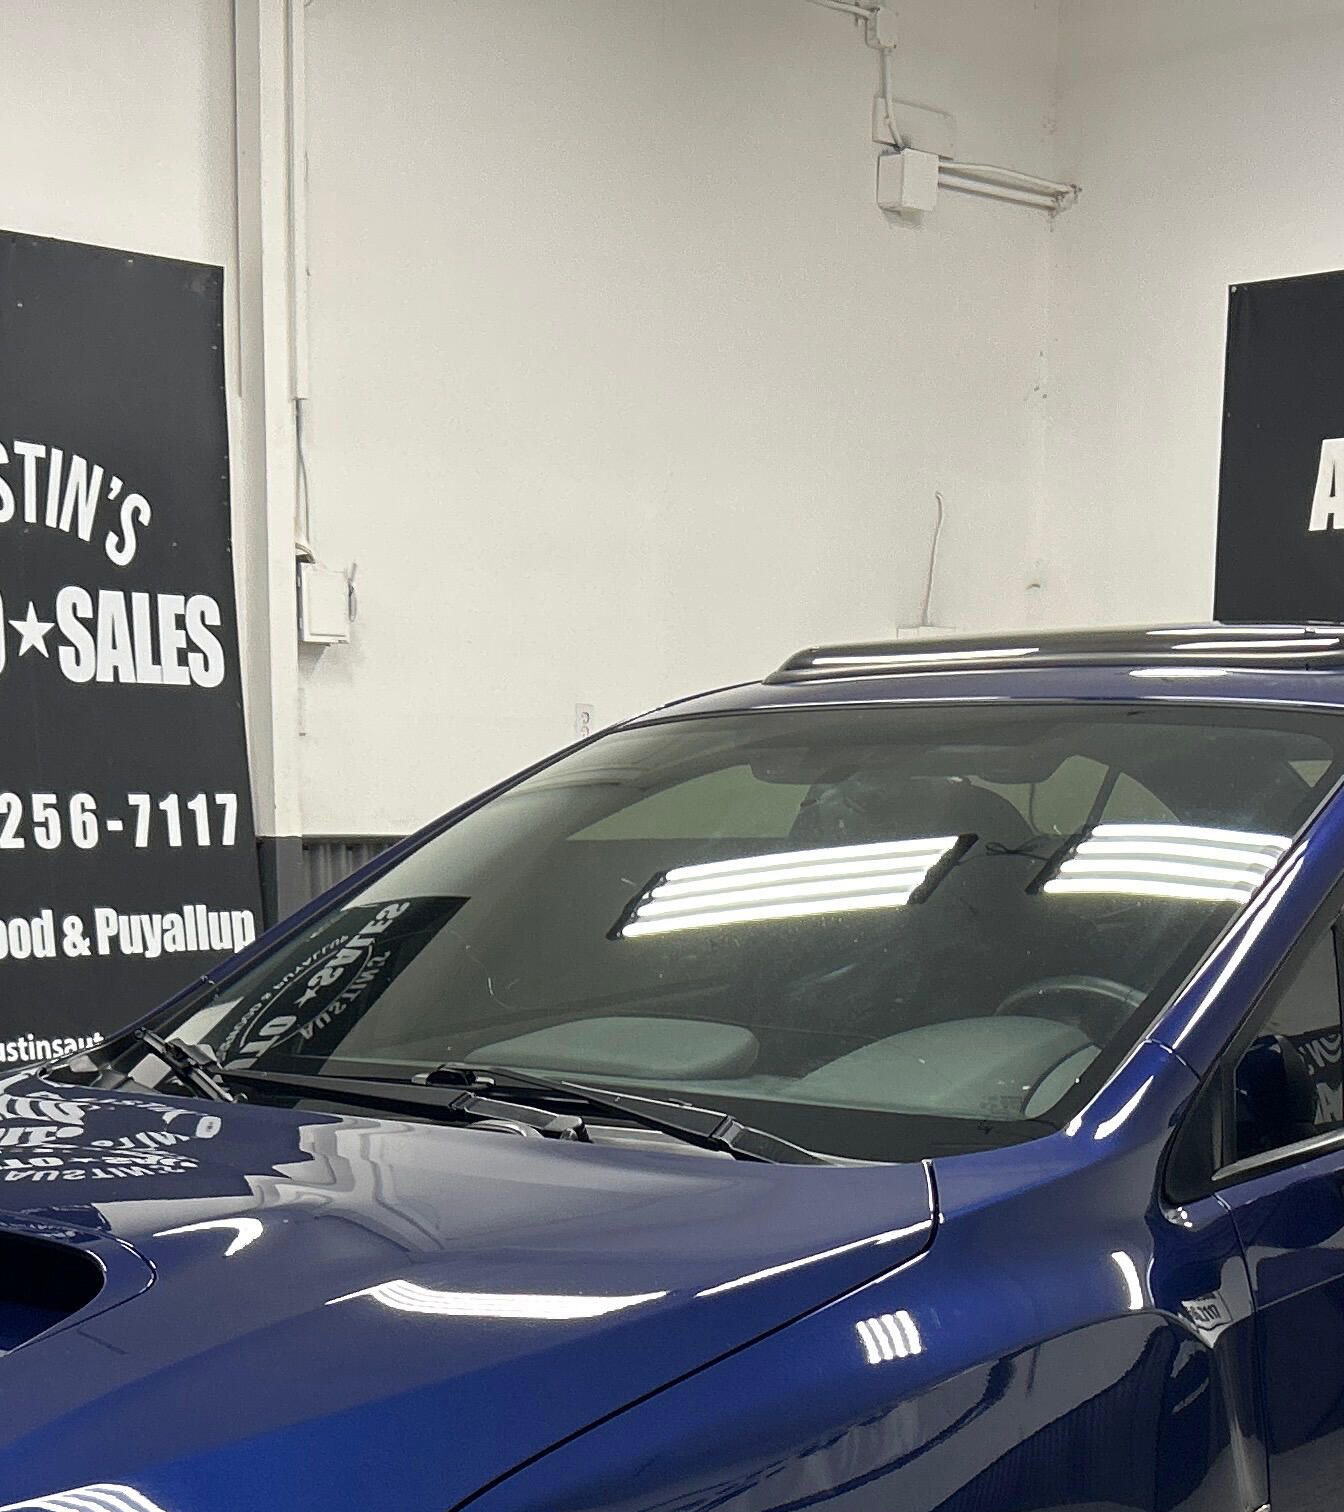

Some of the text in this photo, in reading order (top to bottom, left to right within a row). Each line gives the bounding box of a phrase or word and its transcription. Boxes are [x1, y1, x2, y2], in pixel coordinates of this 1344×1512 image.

[56, 586, 226, 689] SALES
[62, 915, 92, 958] &
[94, 904, 256, 958] Puyallup
